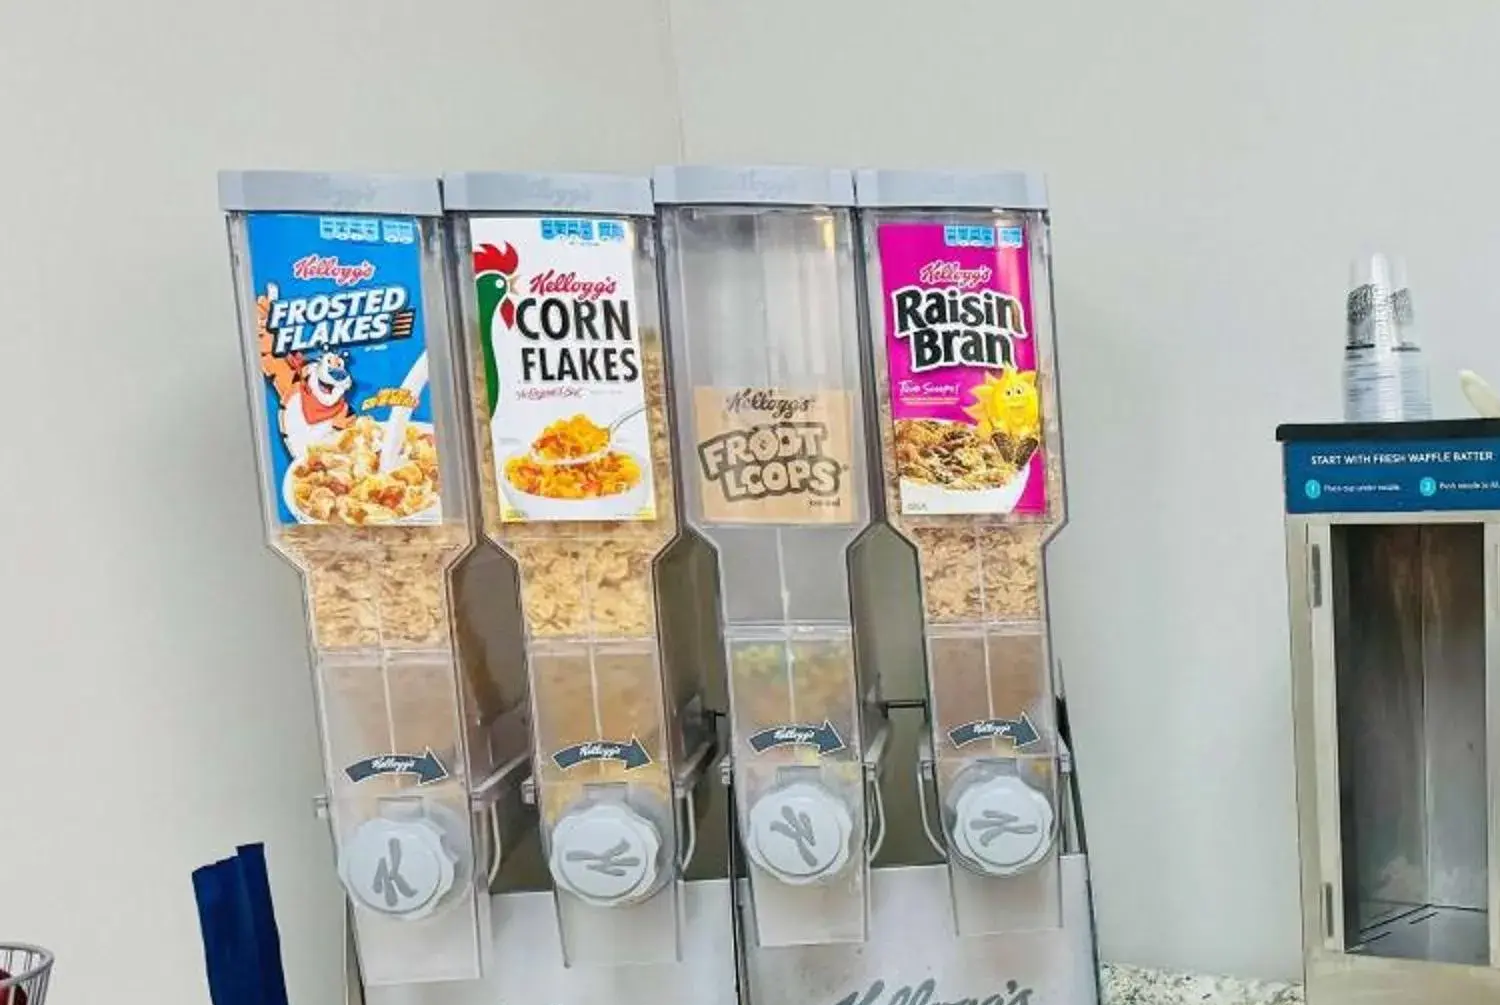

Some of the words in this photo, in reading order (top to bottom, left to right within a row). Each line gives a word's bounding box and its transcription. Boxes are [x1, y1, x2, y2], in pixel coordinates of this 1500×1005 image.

[294, 255, 375, 286] Kellogg's
[530, 269, 617, 300] Kellogg's
[920, 260, 992, 288] Kellogg's
[269, 287, 405, 328] FROSTED
[516, 297, 632, 341] CORN
[895, 289, 1023, 334] Raisin
[274, 313, 391, 354] FLAKES
[912, 327, 1014, 370] Bran
[521, 347, 639, 382] FLAKES
[725, 387, 815, 418] Kellogg's
[1311, 455, 1342, 465] START
[1344, 454, 1371, 465] WITH
[1408, 452, 1452, 463] WAFFLE
[1453, 451, 1494, 461] BATTER
[773, 728, 815, 742] Kellogg's
[973, 722, 1011, 736] Kellogg's
[372, 758, 415, 772] Kellogg's
